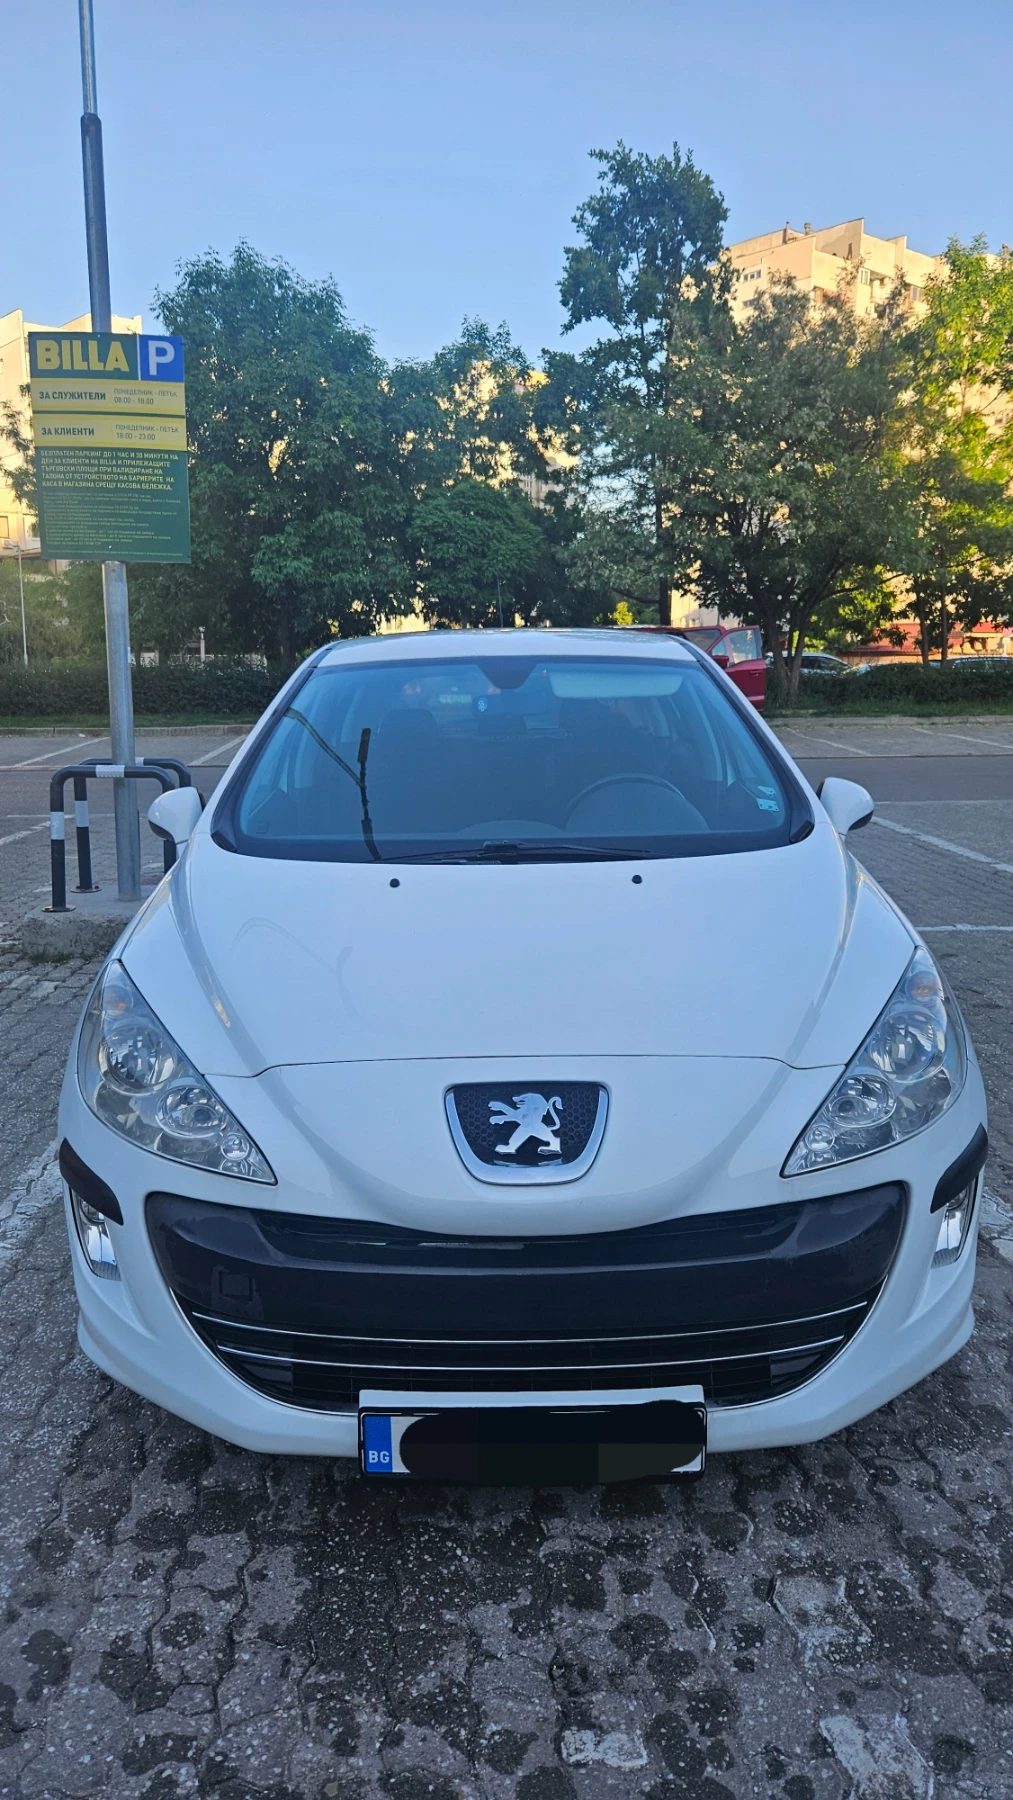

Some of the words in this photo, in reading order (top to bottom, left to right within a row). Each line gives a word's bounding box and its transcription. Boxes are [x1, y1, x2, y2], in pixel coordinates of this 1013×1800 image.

[36, 340, 130, 372] BILLA
[148, 340, 175, 376] P
[39, 391, 50, 399] ЗА
[52, 391, 106, 400] СЛУЖИТЕЛИ
[114, 388, 154, 396] ПОНЕДЕЛНИК
[42, 428, 53, 436] ЗА
[54, 428, 94, 436] КЛИЕНТИ
[368, 1450, 390, 1464] BG
